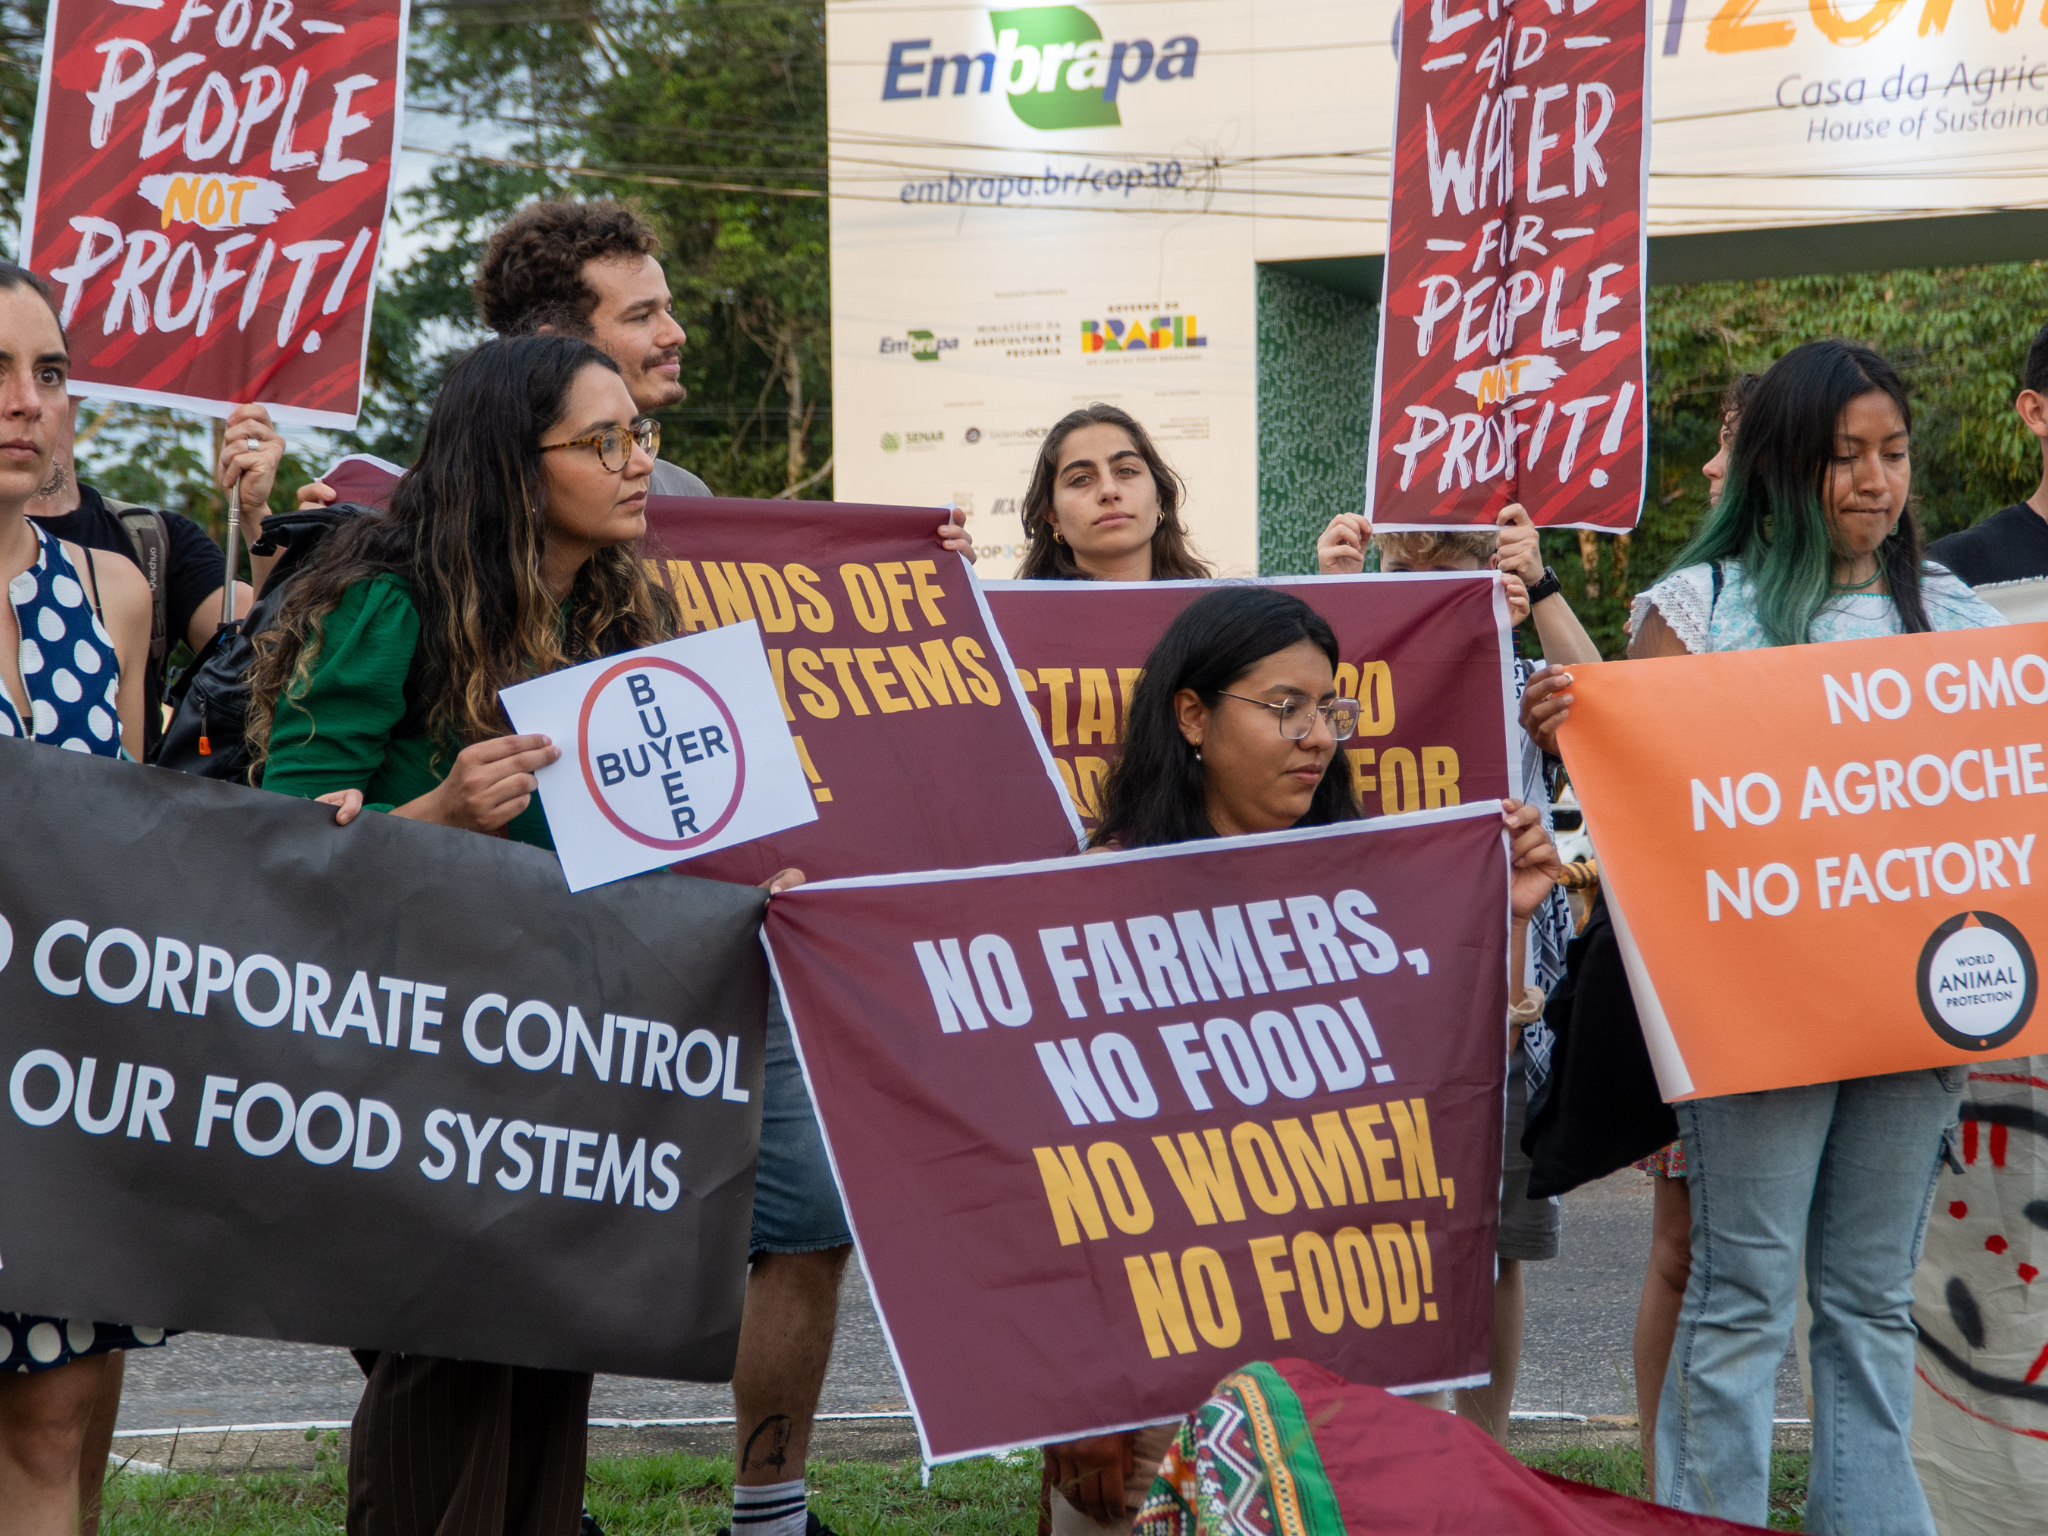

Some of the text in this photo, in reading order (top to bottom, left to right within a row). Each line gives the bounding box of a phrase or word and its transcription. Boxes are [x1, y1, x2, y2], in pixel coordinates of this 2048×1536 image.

[881, 29, 1200, 101] Embrapa
[1775, 55, 2047, 110] Casa da Agric
[86, 37, 378, 181] PEOPLE
[1807, 117, 1891, 143] House
[1899, 107, 1929, 141] of
[900, 159, 1182, 205] embrapa.br/cop30
[1426, 82, 1616, 217] WATER
[160, 176, 257, 229] NOT
[49, 216, 372, 354] PROFIT!
[1107, 301, 1180, 313] GOVERNO DO
[1413, 263, 1624, 361] PEOPLE
[1081, 314, 1207, 354] BRASIL
[1393, 381, 1636, 493] PROFIT!
[148, 547, 158, 592] Quechua
[839, 560, 946, 633] OFF
[1822, 653, 2048, 724] NO GMO
[596, 725, 729, 787] BUYER
[626, 673, 700, 839] BUYER
[1690, 743, 2048, 831] NO AGROCHE
[1705, 833, 2037, 921] NO FACTORY
[913, 889, 1430, 1034] NO FARMERS,
[1938, 966, 2017, 993] ANIMAL
[1946, 990, 2013, 1008] PROTECTION
[1956, 953, 1995, 967] WORLD
[33, 919, 447, 1055] CORPORATE
[462, 993, 750, 1103] CONTROL
[1034, 996, 1396, 1126] NO FOOD!
[9, 1048, 681, 1212] OUR FOOD SYSTEMS
[1032, 1097, 1455, 1247] NO WOMEN,
[1123, 1220, 1439, 1359] NO FOOD!
